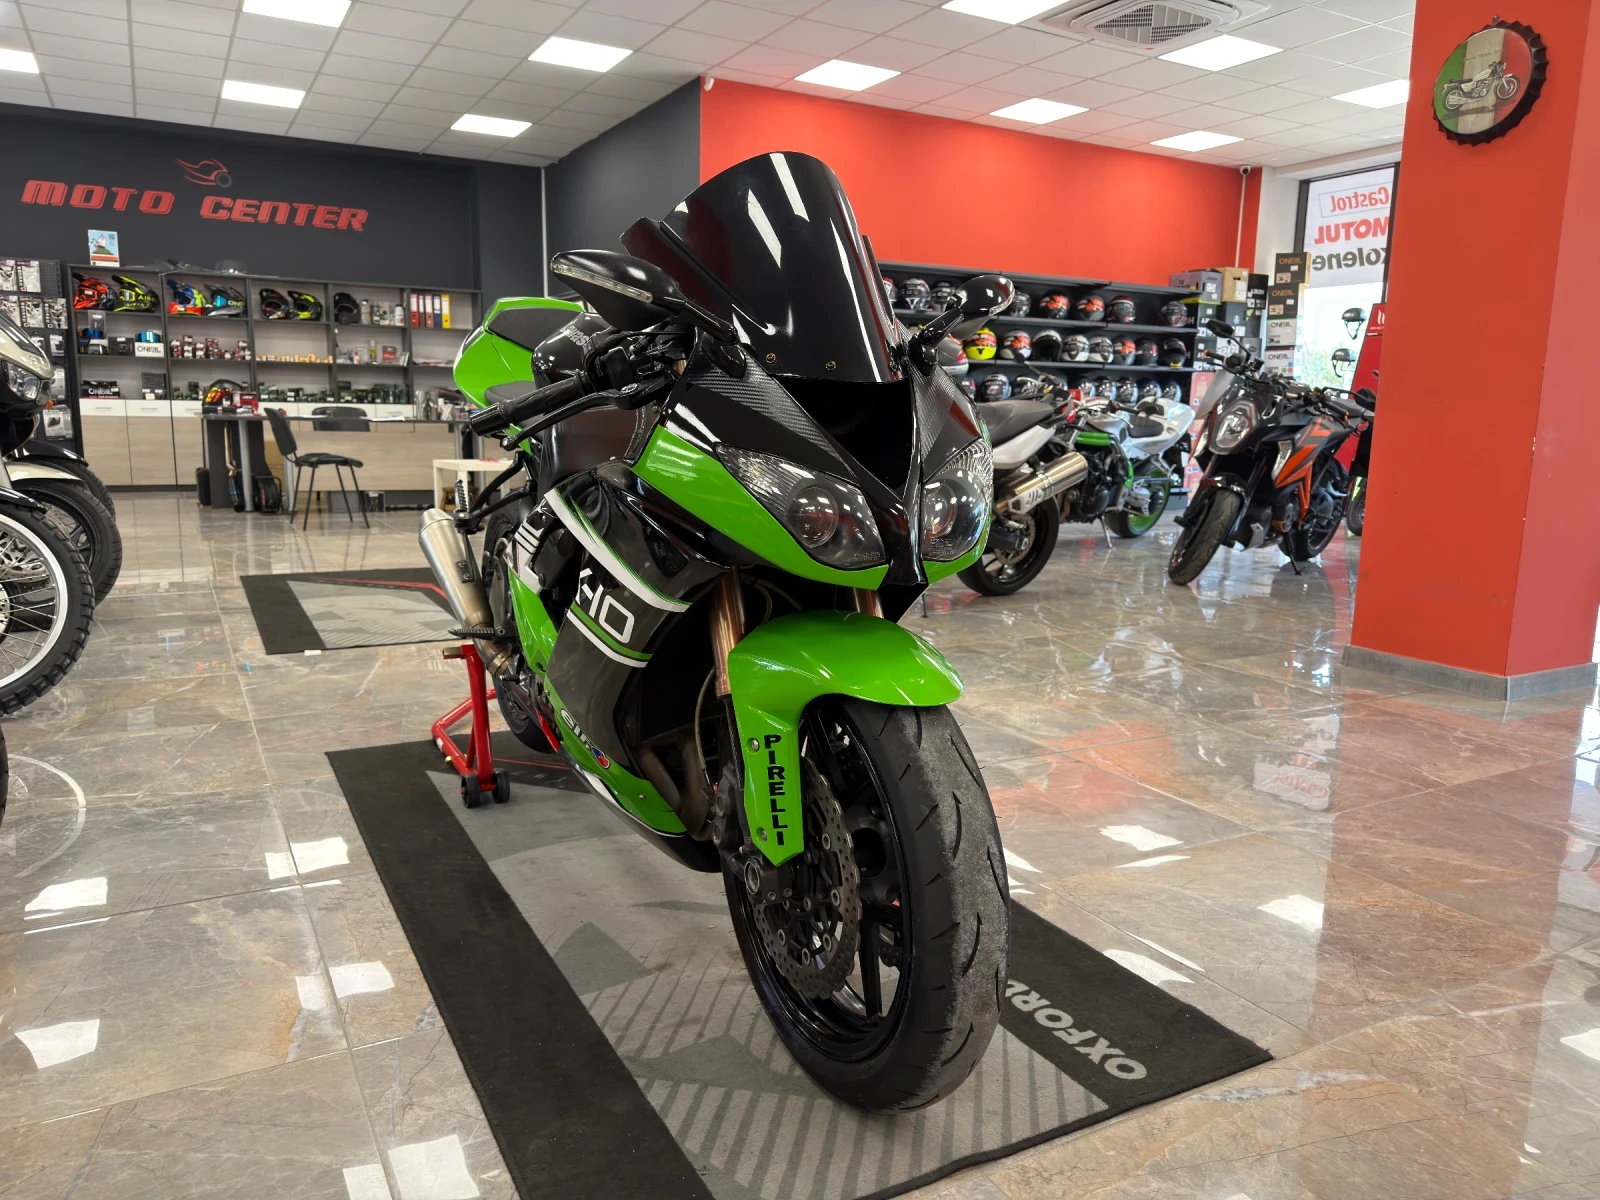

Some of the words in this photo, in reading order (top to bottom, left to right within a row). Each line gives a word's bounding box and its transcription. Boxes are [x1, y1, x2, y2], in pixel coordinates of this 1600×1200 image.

[21, 180, 174, 215] MOTO
[200, 196, 368, 231] CENTER
[763, 733, 788, 846] PIRELLI
